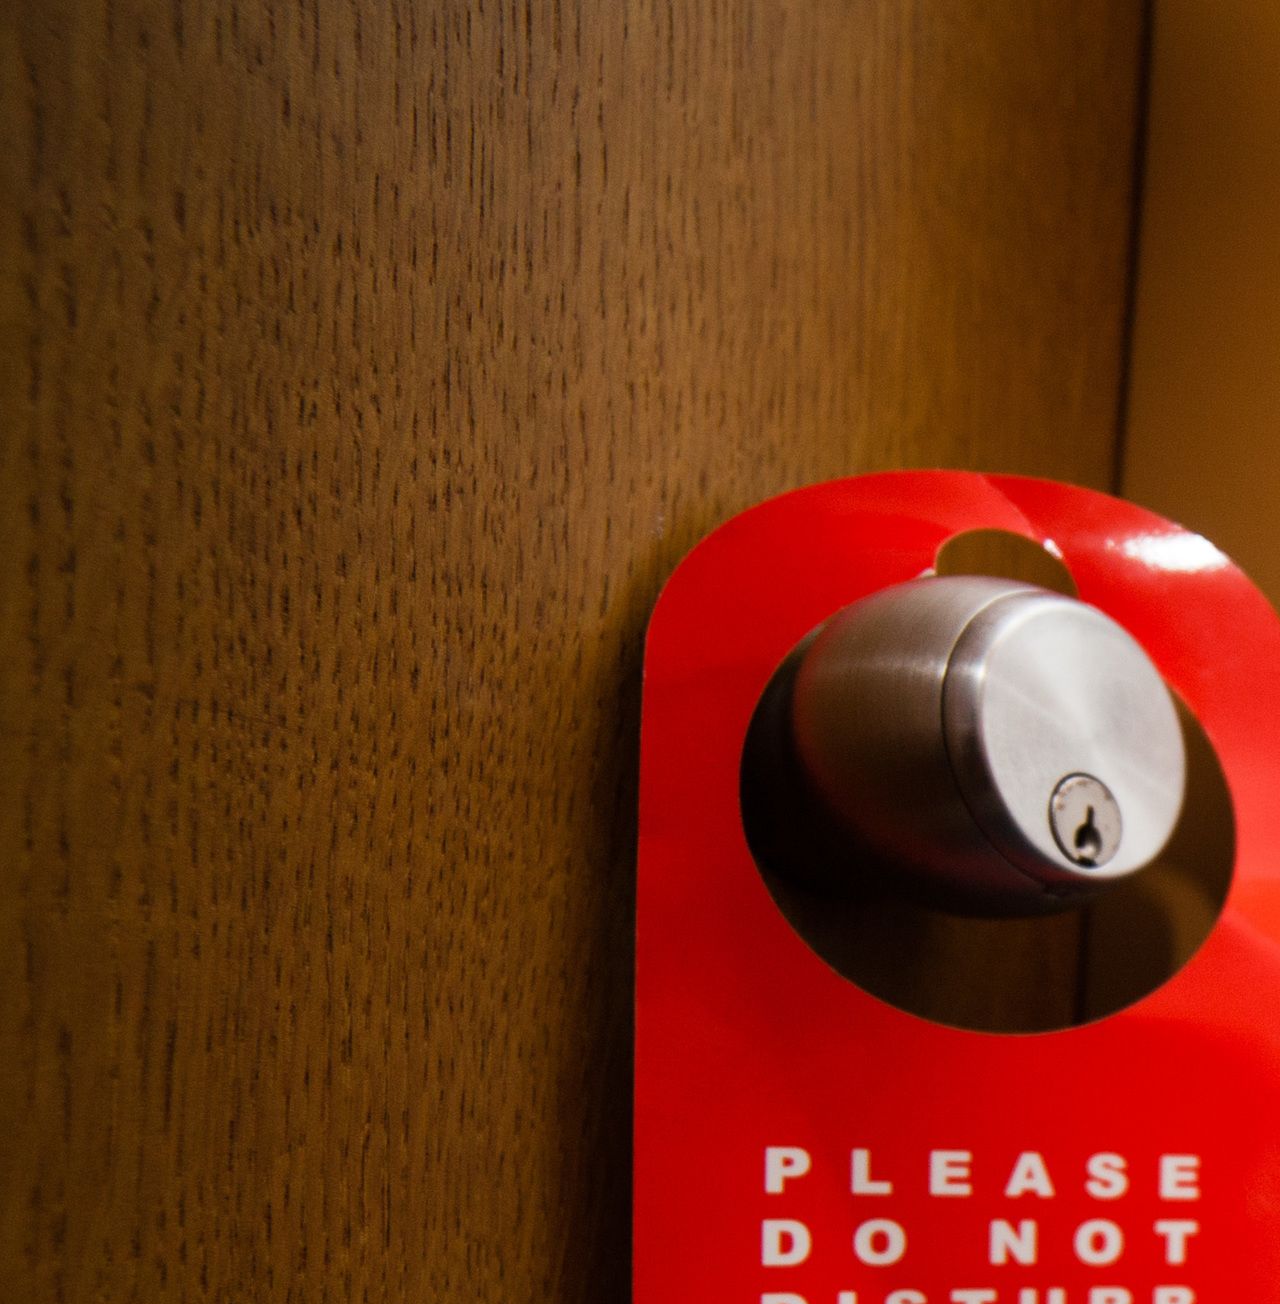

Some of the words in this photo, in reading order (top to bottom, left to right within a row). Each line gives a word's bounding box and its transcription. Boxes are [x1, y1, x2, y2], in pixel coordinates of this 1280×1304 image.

[764, 1145, 1201, 1200] PLEASE
[760, 1217, 907, 1268] DO
[988, 1218, 1200, 1267] NOT
